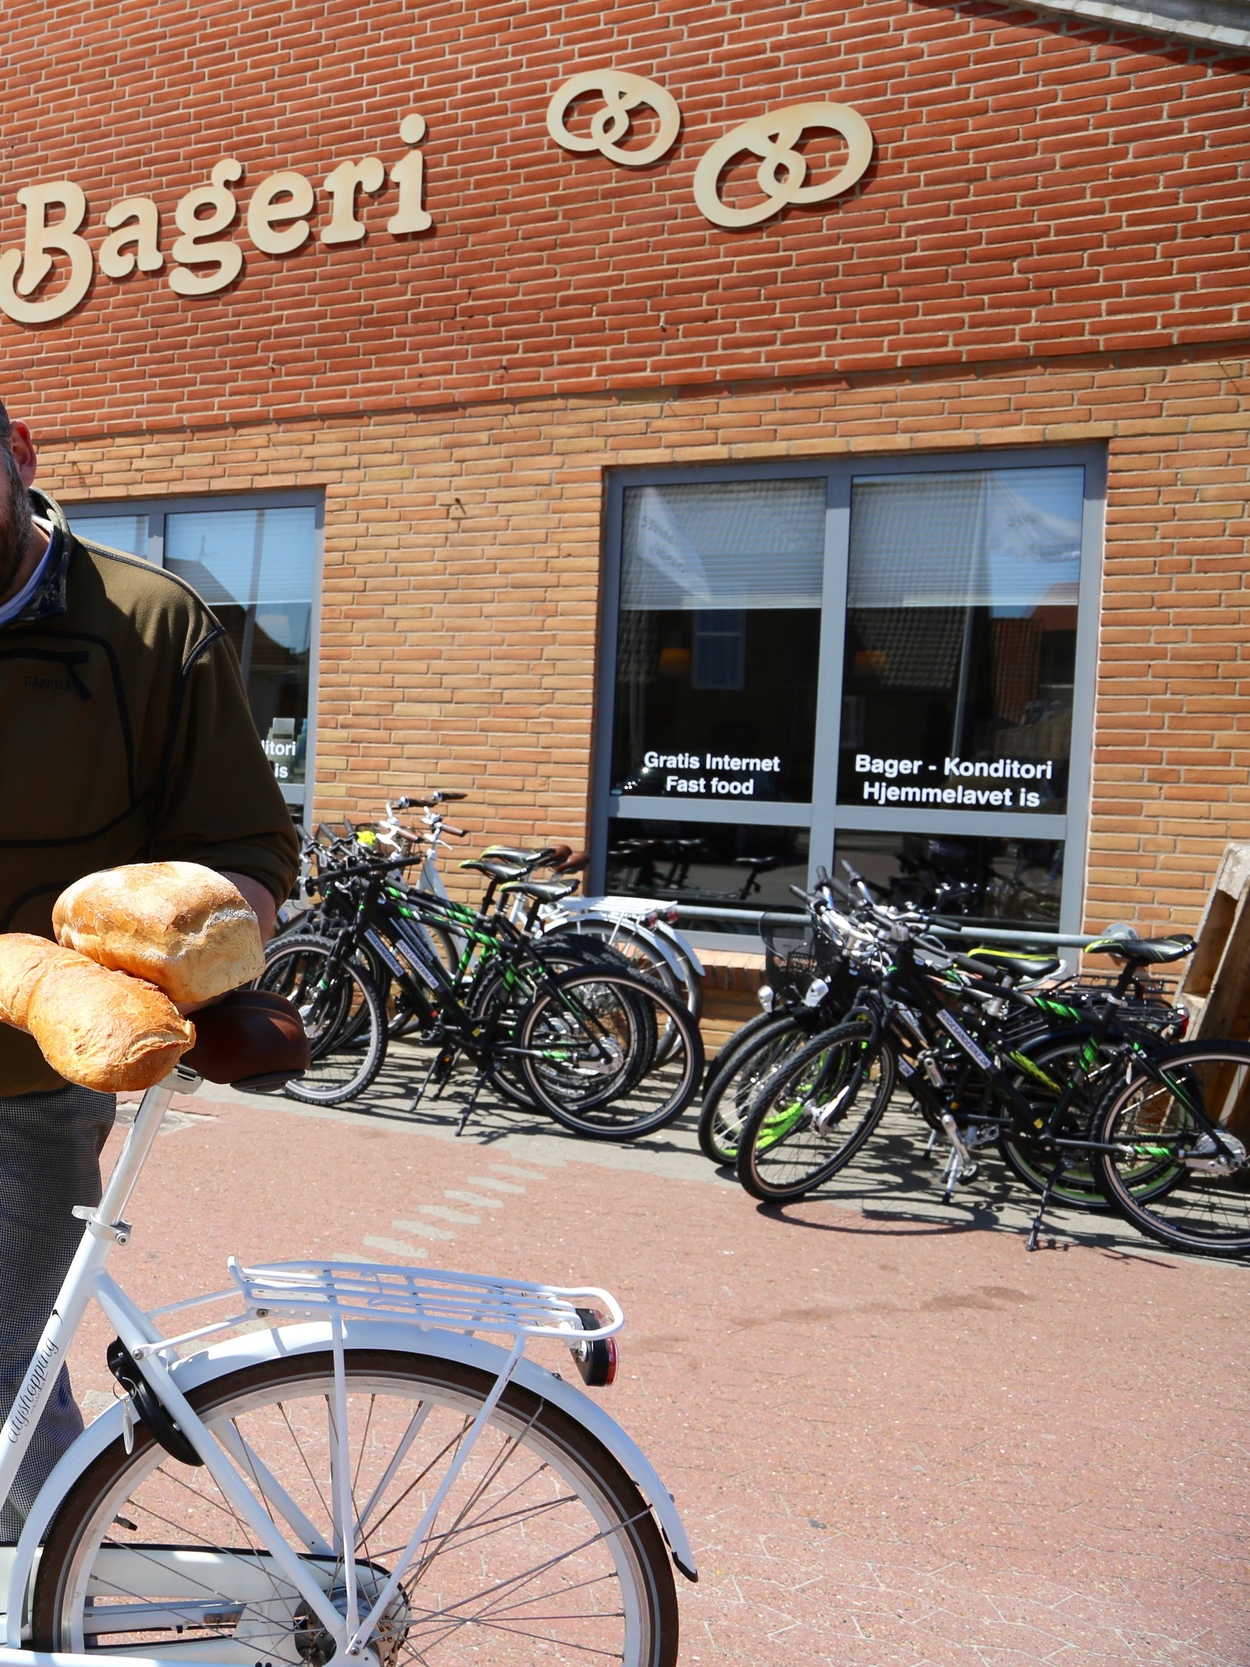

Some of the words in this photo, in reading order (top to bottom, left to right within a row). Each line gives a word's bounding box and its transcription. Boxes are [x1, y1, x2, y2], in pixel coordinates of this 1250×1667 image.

[260, 740, 297, 756] itori
[274, 763, 289, 778] is
[644, 751, 700, 769] Gratis
[706, 753, 780, 772] Internet
[855, 754, 923, 778] Bager
[944, 757, 1053, 779] Konditori
[666, 775, 706, 793] Fast
[711, 777, 755, 795] food
[863, 781, 1013, 805] Hjemmelavet
[1020, 788, 1041, 807] is
[7, 1337, 59, 1444] cityshopping
